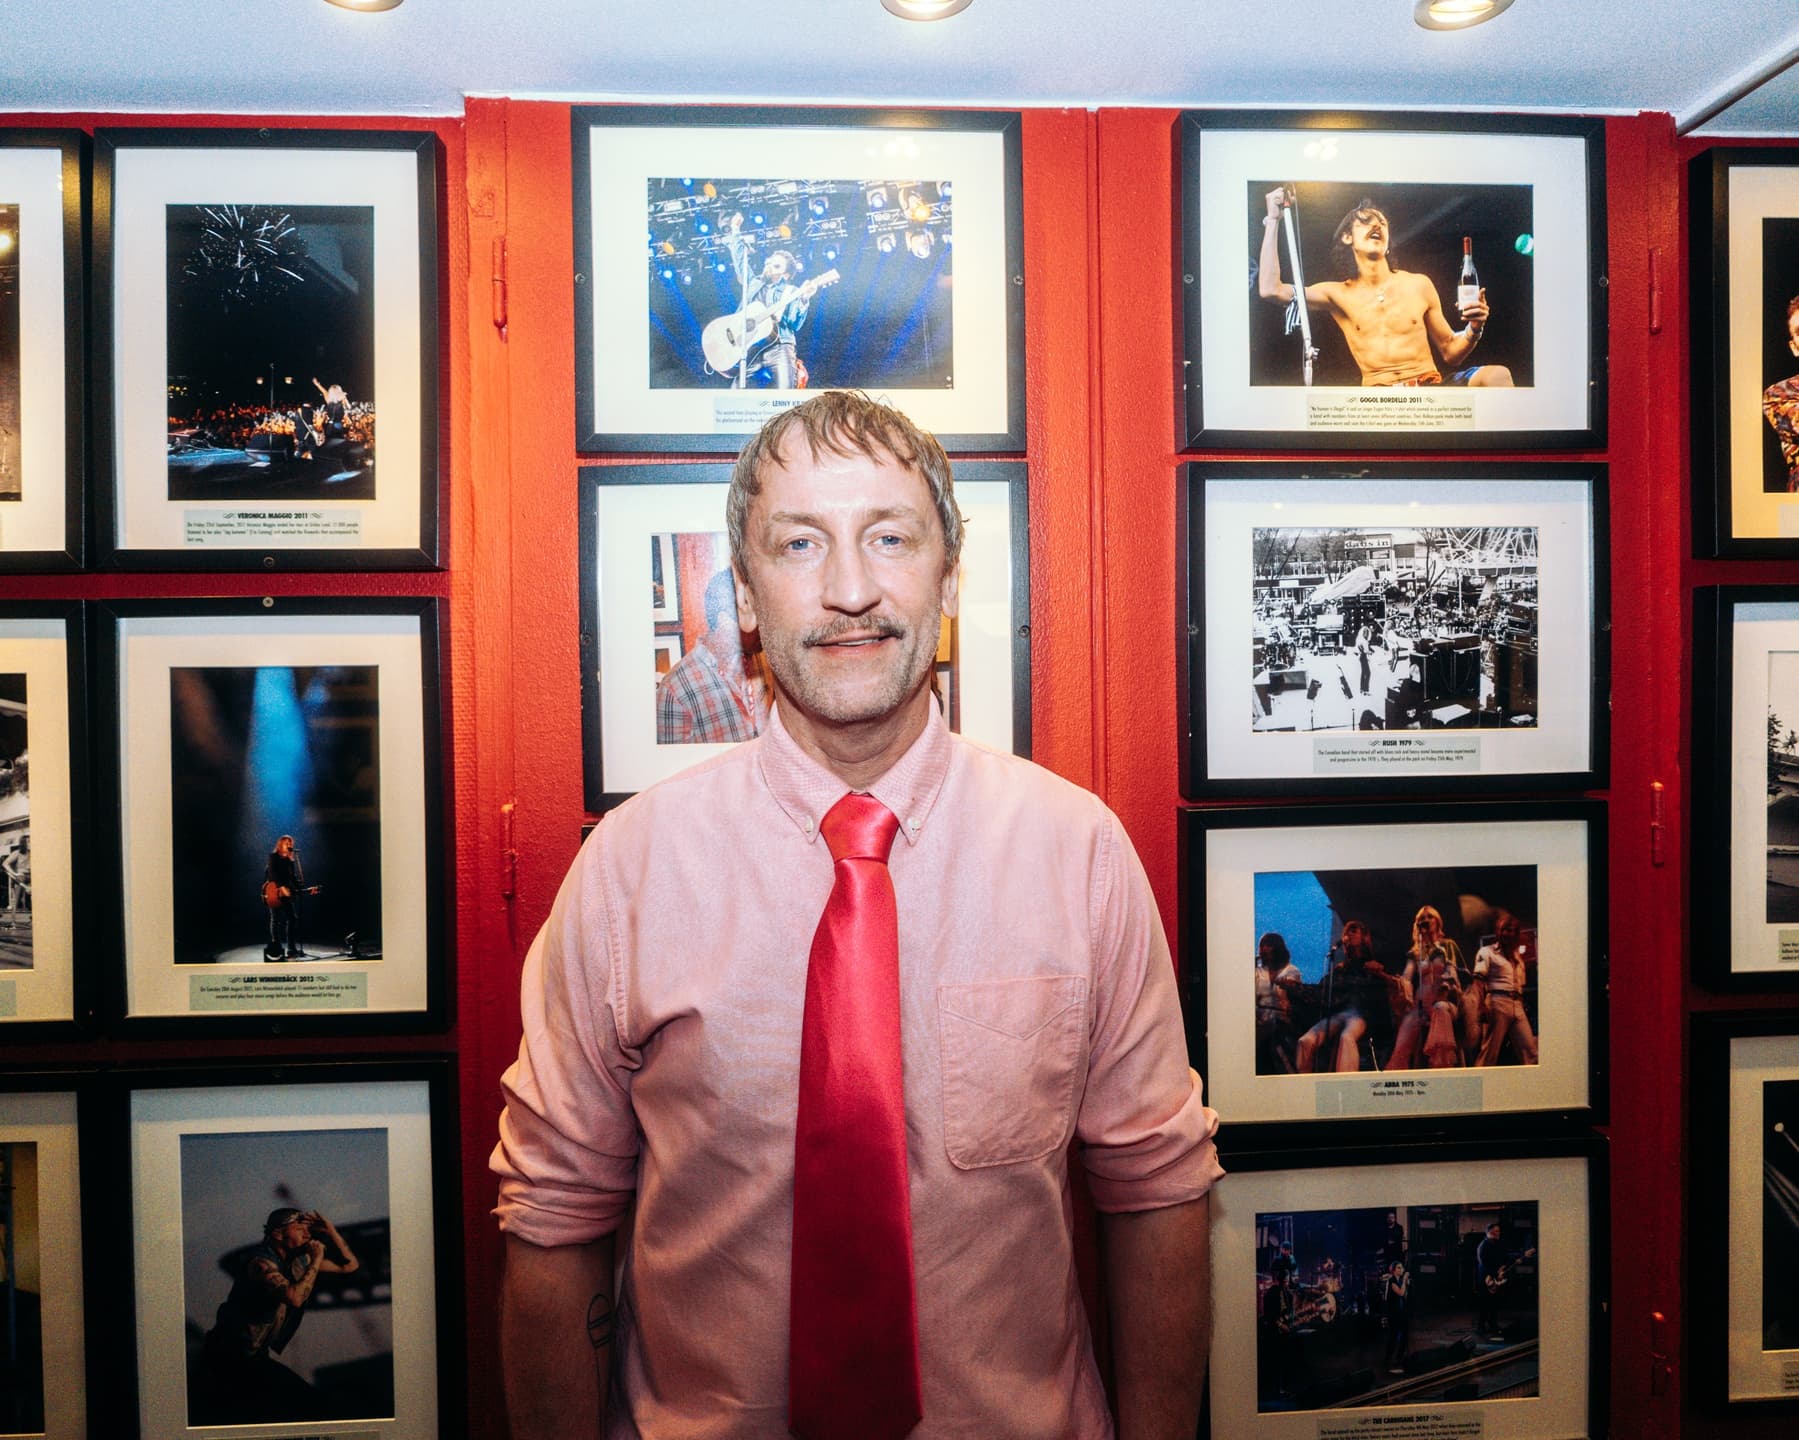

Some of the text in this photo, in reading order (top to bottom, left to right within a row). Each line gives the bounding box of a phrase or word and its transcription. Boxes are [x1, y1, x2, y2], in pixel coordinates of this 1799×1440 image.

[1360, 396, 1422, 404] GOGOL BORDELLO 2011
[259, 975, 298, 983] WINNERBÄCK
